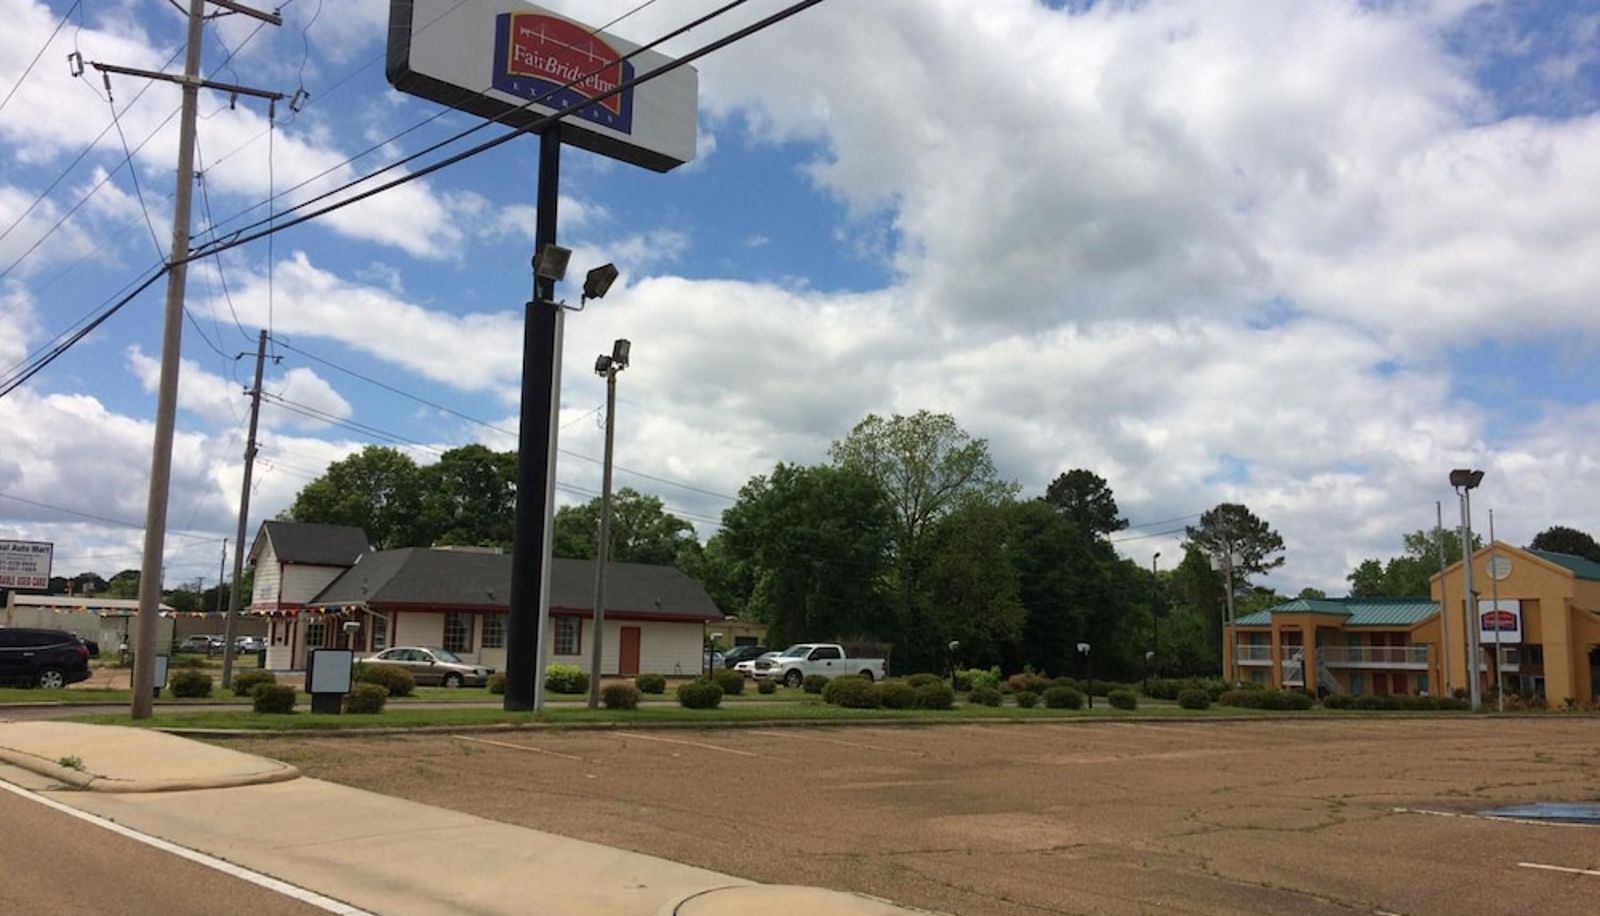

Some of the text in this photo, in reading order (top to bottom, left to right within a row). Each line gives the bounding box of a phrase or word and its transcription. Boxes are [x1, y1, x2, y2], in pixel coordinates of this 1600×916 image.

[513, 82, 613, 123] EXPRSS
[12, 544, 30, 552] Auto
[32, 545, 50, 553] Mart
